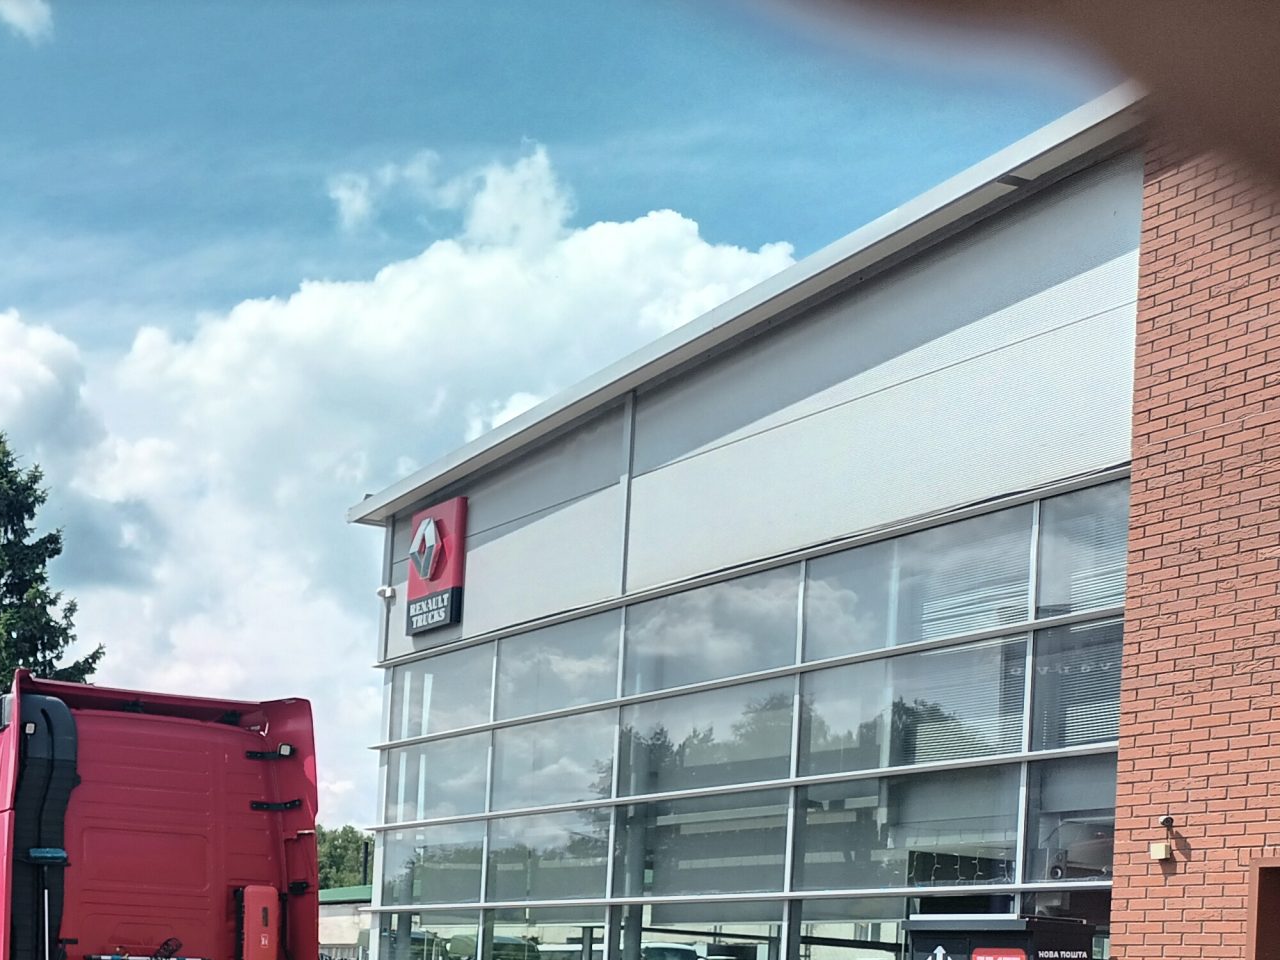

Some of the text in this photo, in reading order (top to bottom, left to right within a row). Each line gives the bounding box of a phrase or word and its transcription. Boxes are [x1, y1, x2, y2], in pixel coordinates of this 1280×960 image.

[410, 593, 450, 617] RENAULT
[412, 608, 445, 628] TRUCKS
[1038, 950, 1088, 959] НОВА ПОШТА
